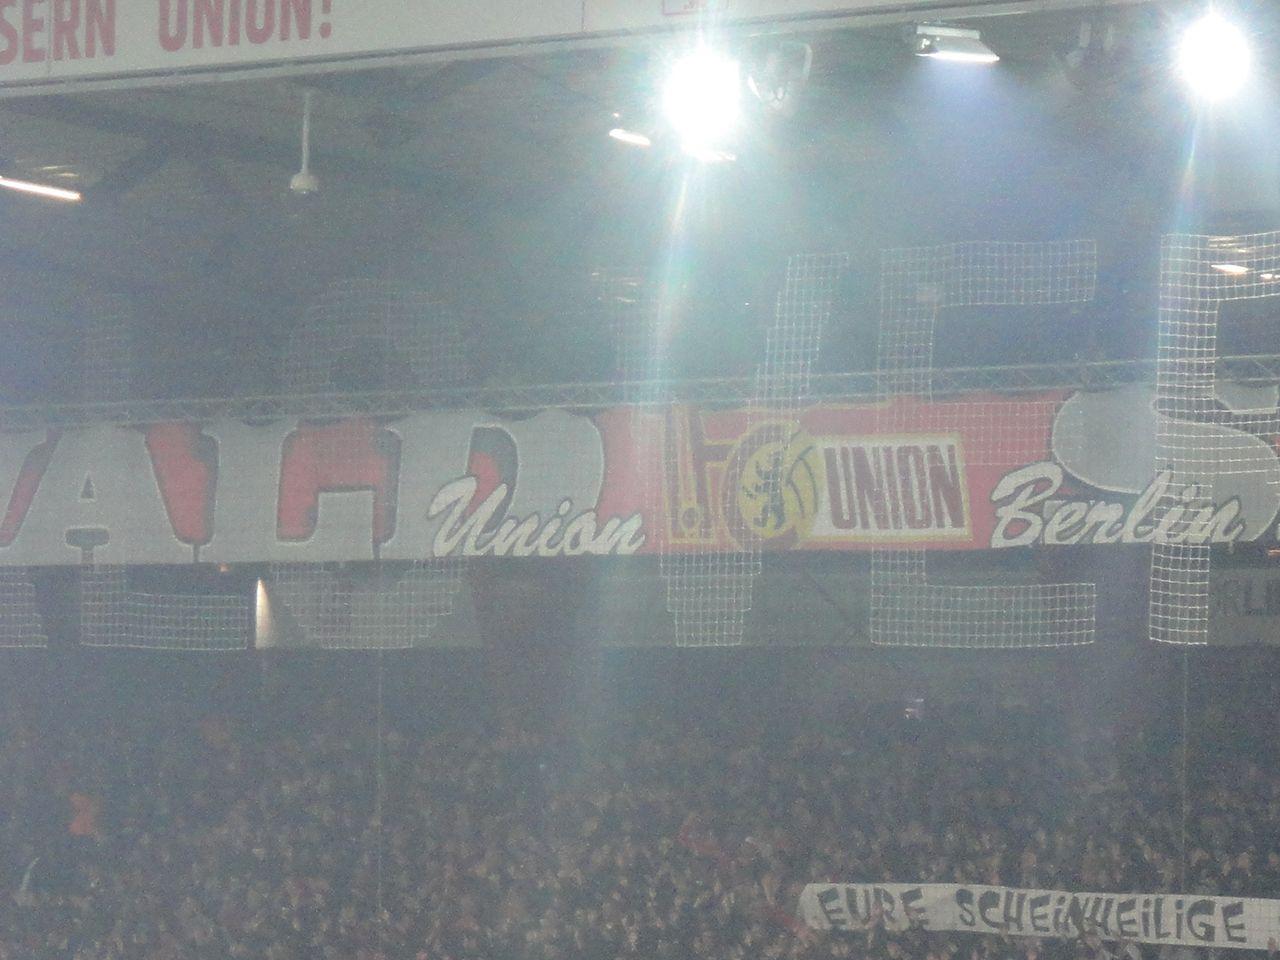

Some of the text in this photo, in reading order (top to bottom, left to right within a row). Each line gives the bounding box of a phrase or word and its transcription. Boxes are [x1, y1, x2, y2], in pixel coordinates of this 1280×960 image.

[429, 475, 646, 557] Union
[821, 443, 966, 531] UNION
[989, 463, 1249, 547] Berlin
[818, 886, 927, 930] EURE
